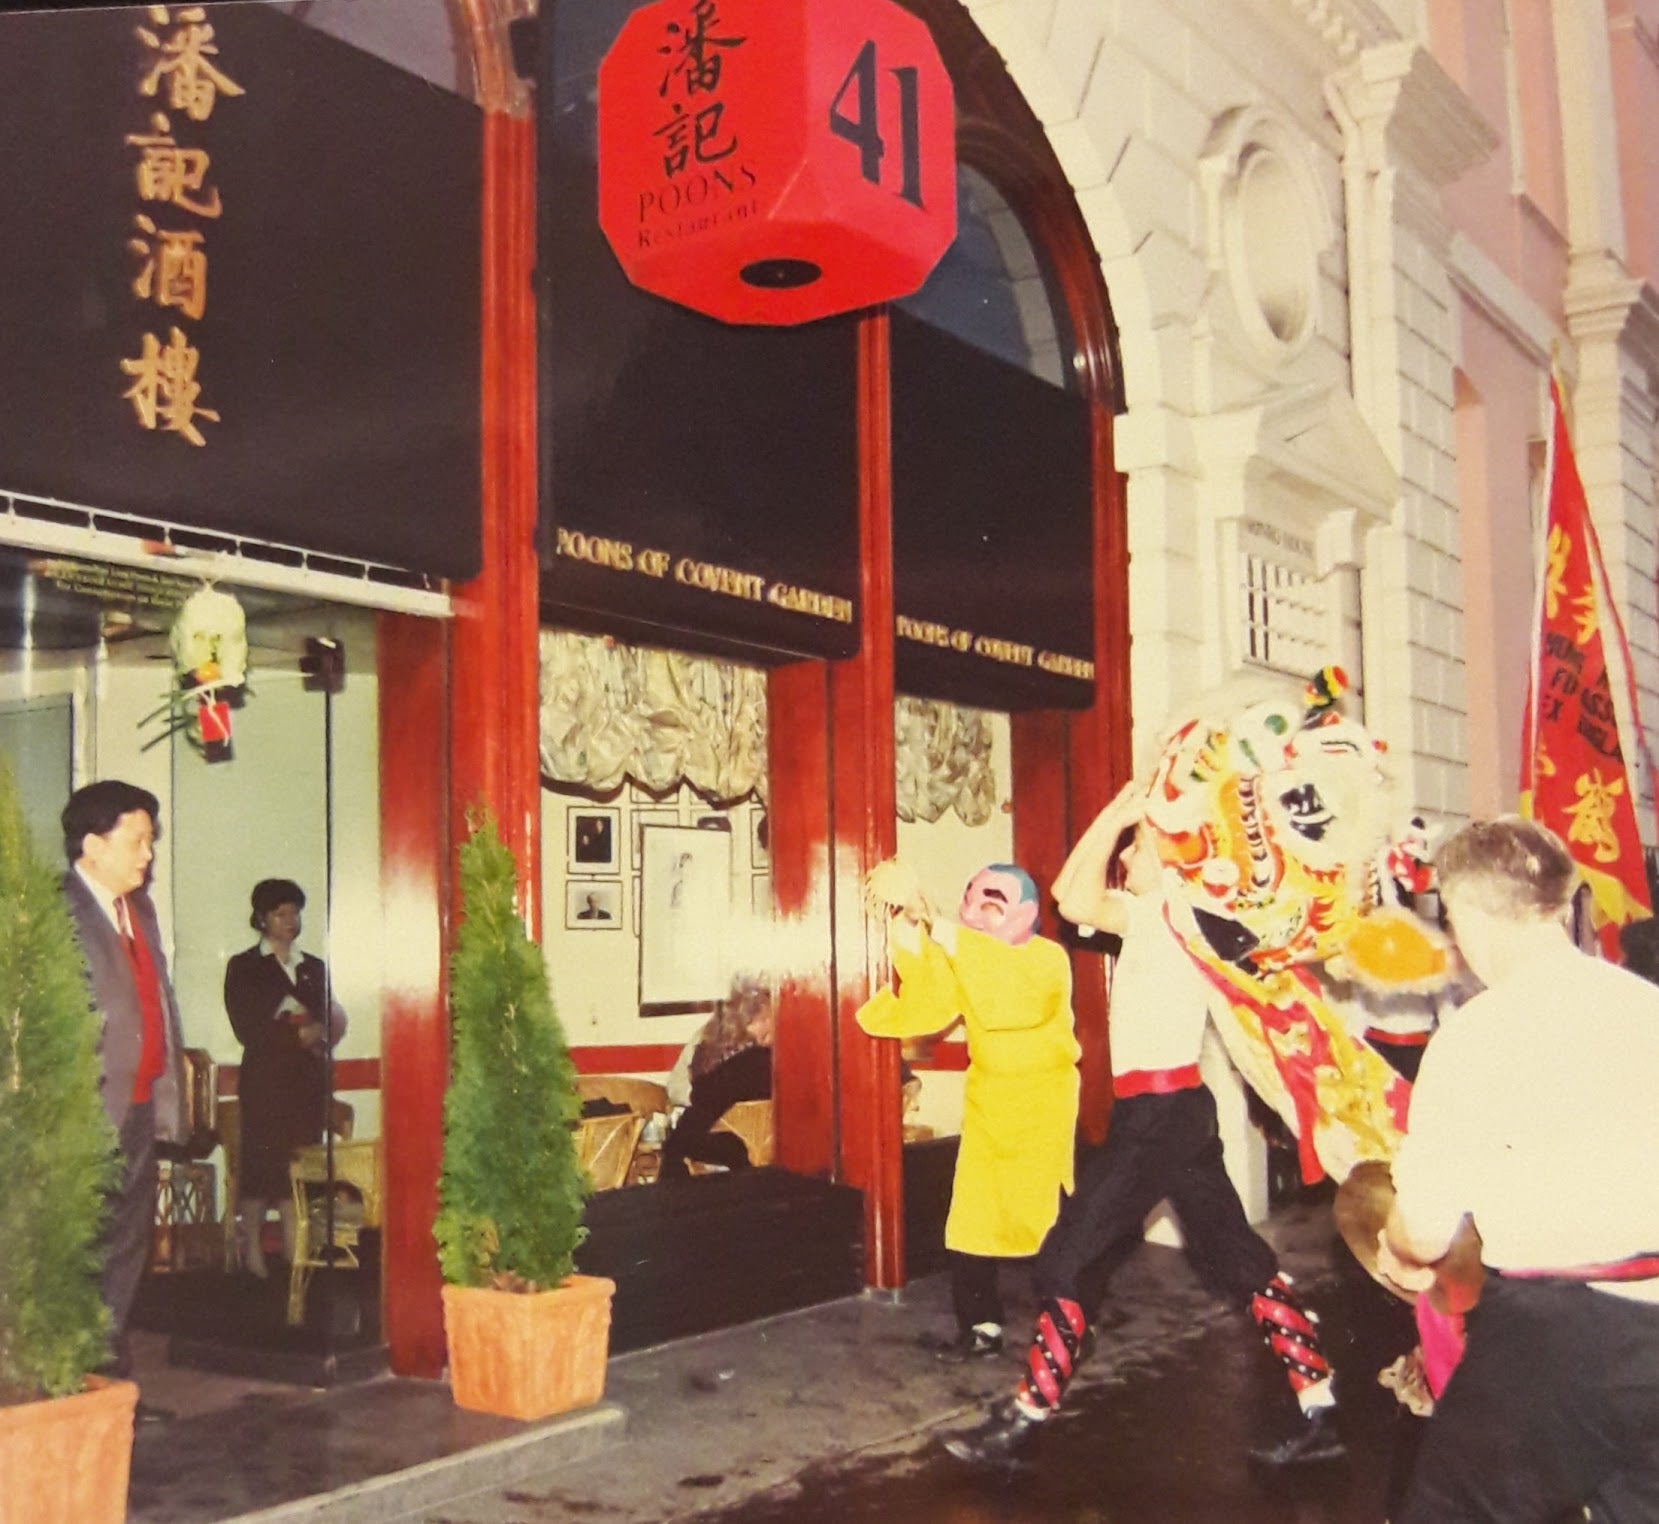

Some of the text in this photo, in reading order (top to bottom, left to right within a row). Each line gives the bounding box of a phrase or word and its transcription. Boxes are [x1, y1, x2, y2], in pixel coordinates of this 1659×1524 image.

[653, 0, 748, 178] 潘記
[829, 38, 928, 214] 41
[120, 5, 246, 447] 潘記酒樓
[639, 165, 757, 223] POONS
[556, 527, 853, 624] POONS OF COVENT GARDEN
